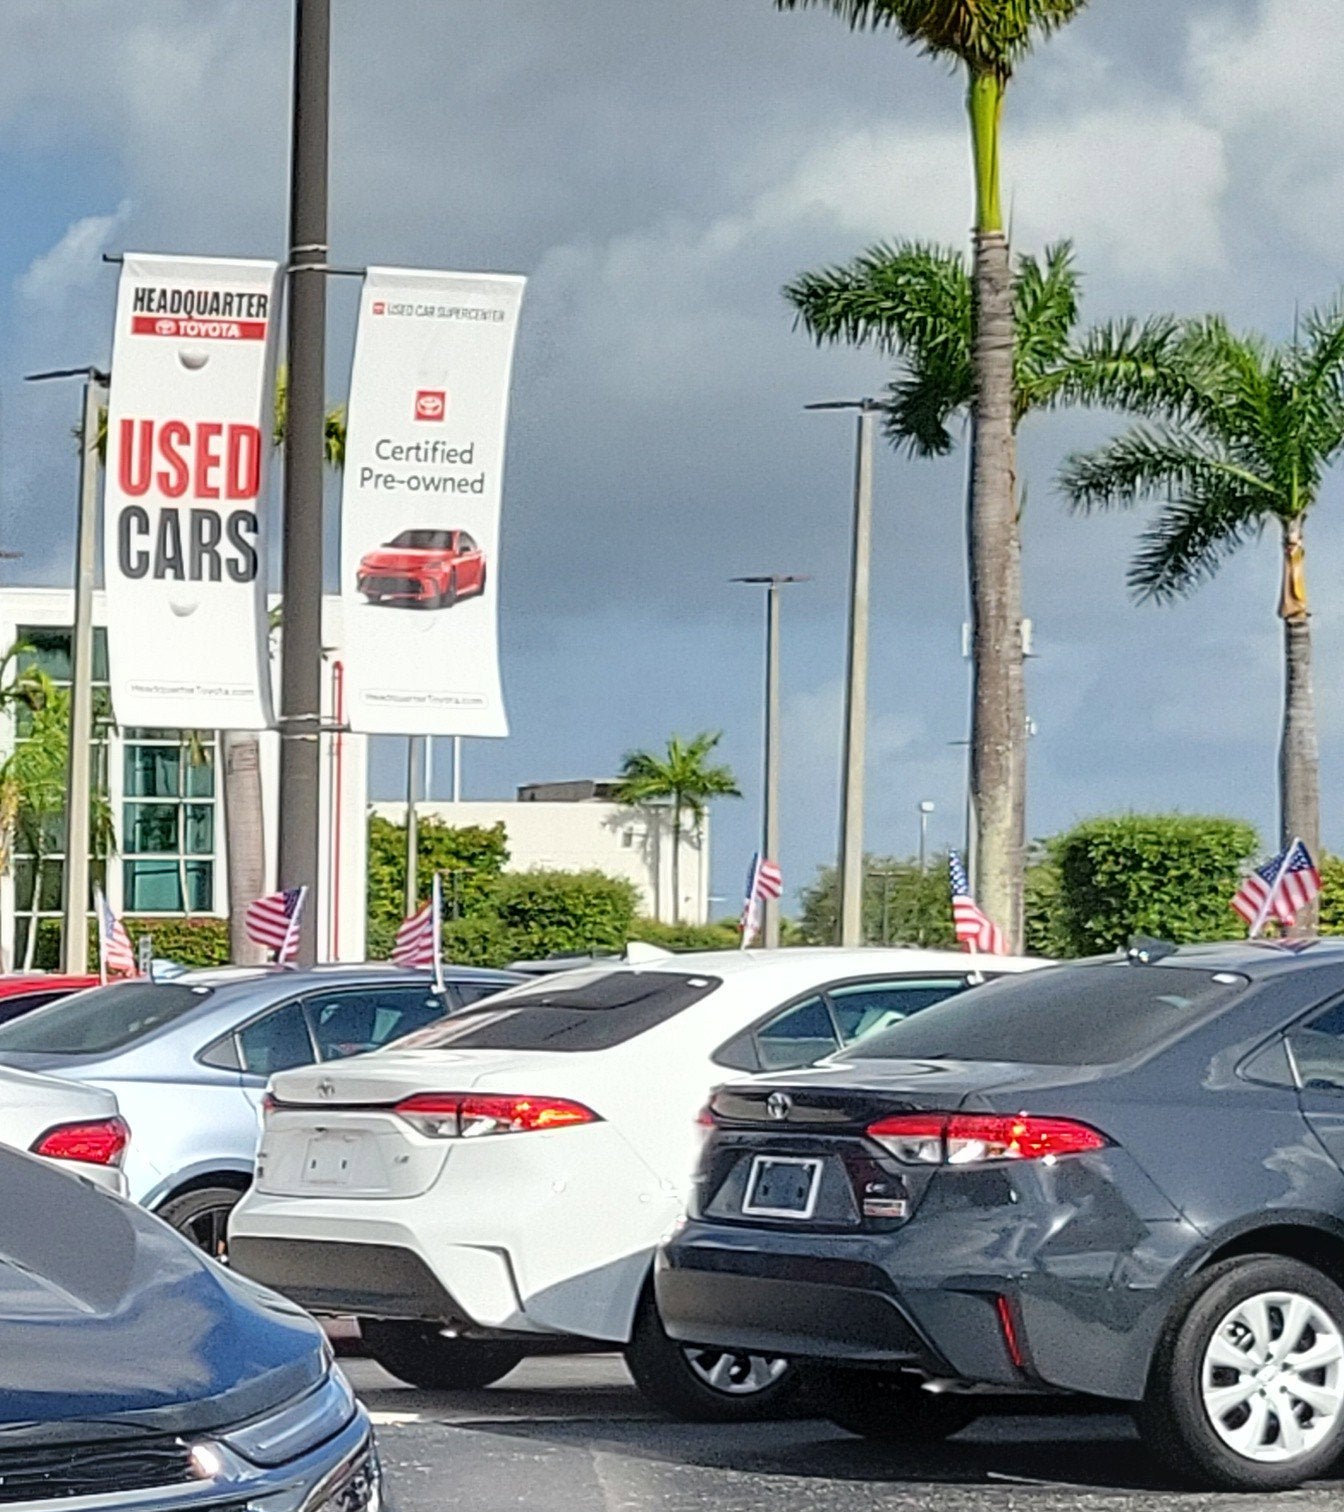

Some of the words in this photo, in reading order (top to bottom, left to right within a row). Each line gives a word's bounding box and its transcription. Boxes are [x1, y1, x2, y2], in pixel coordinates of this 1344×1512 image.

[132, 287, 269, 319] HEADQUARTER
[178, 321, 241, 338] TOYOTA
[118, 418, 261, 499] USED
[375, 439, 474, 464] Certified
[360, 467, 485, 494] Pre-owned
[117, 504, 259, 583] CARS
